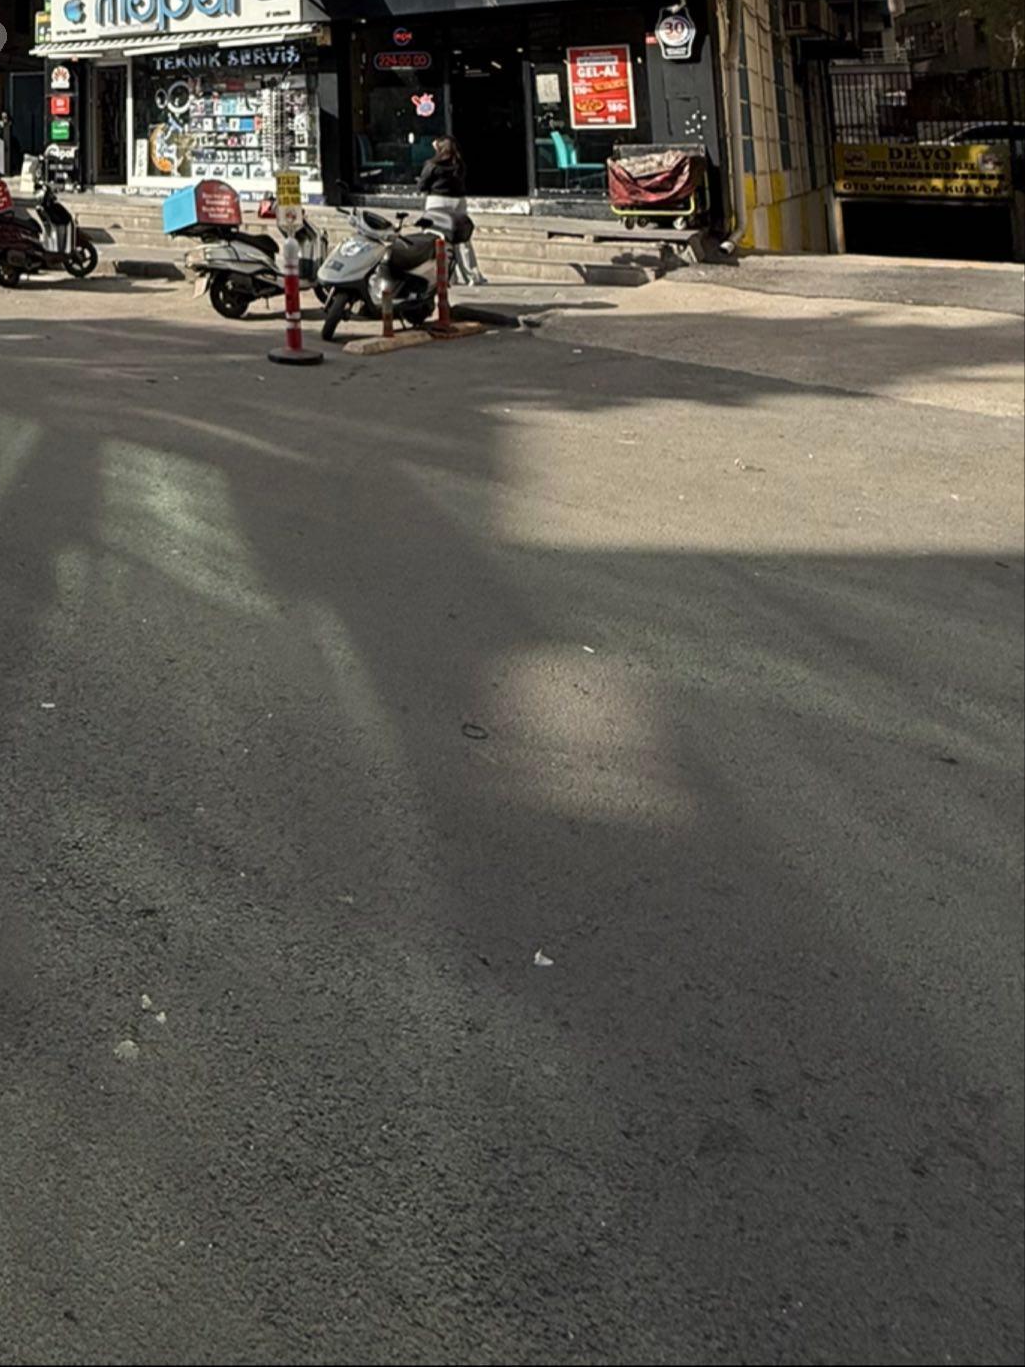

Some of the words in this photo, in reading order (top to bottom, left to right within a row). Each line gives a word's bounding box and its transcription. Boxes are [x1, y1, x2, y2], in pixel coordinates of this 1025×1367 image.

[663, 21, 686, 36] 30
[576, 65, 620, 78] GEL-AL
[889, 147, 952, 161] DEVO
